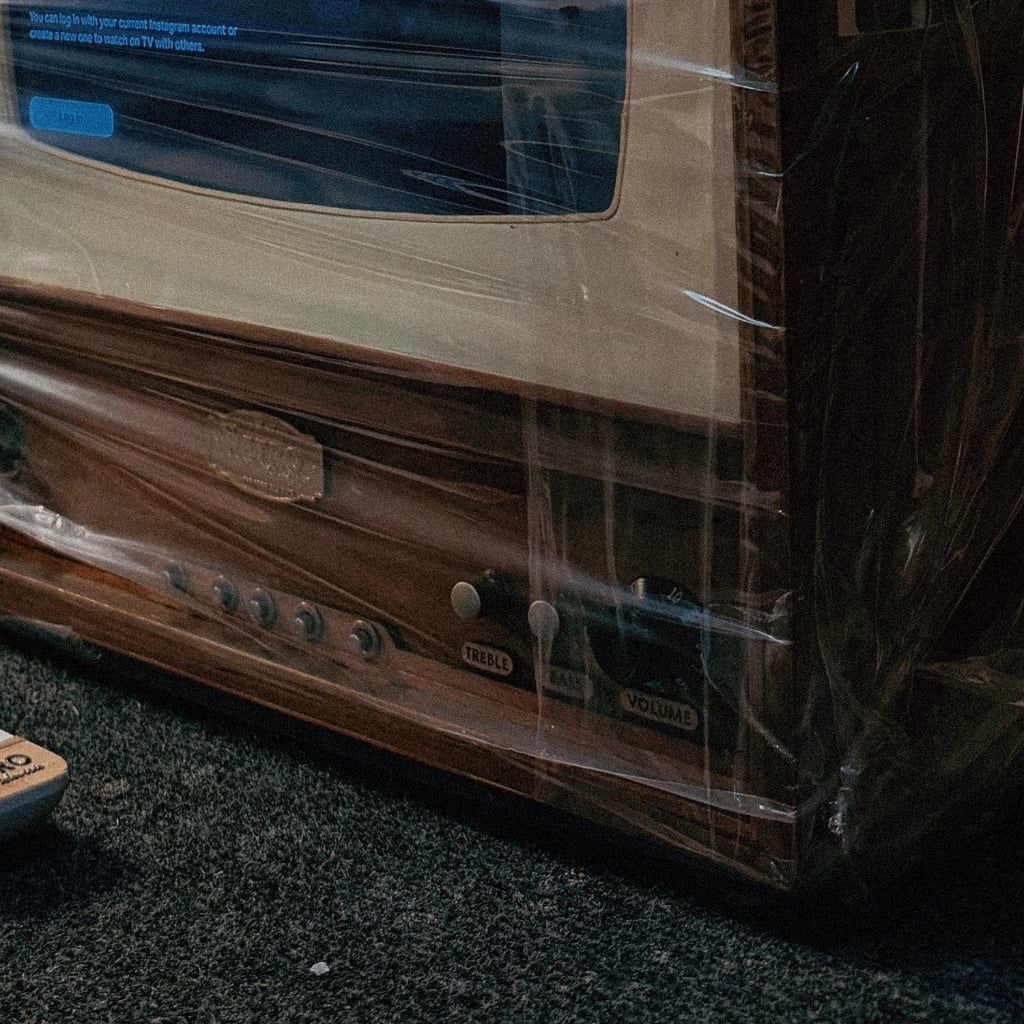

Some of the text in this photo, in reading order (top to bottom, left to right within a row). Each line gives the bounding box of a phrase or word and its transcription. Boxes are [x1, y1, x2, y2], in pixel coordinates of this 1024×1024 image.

[29, 11, 44, 23] You
[44, 13, 58, 24] can
[59, 13, 72, 27] log
[72, 13, 81, 25] in
[81, 14, 98, 26] with
[99, 17, 117, 30] your
[119, 18, 148, 30] current
[191, 23, 226, 36] account
[227, 26, 238, 36] or
[29, 29, 205, 53] create a new one to watch on TV with others.
[464, 644, 510, 672] TREBLE
[626, 691, 693, 724] VOLUME
